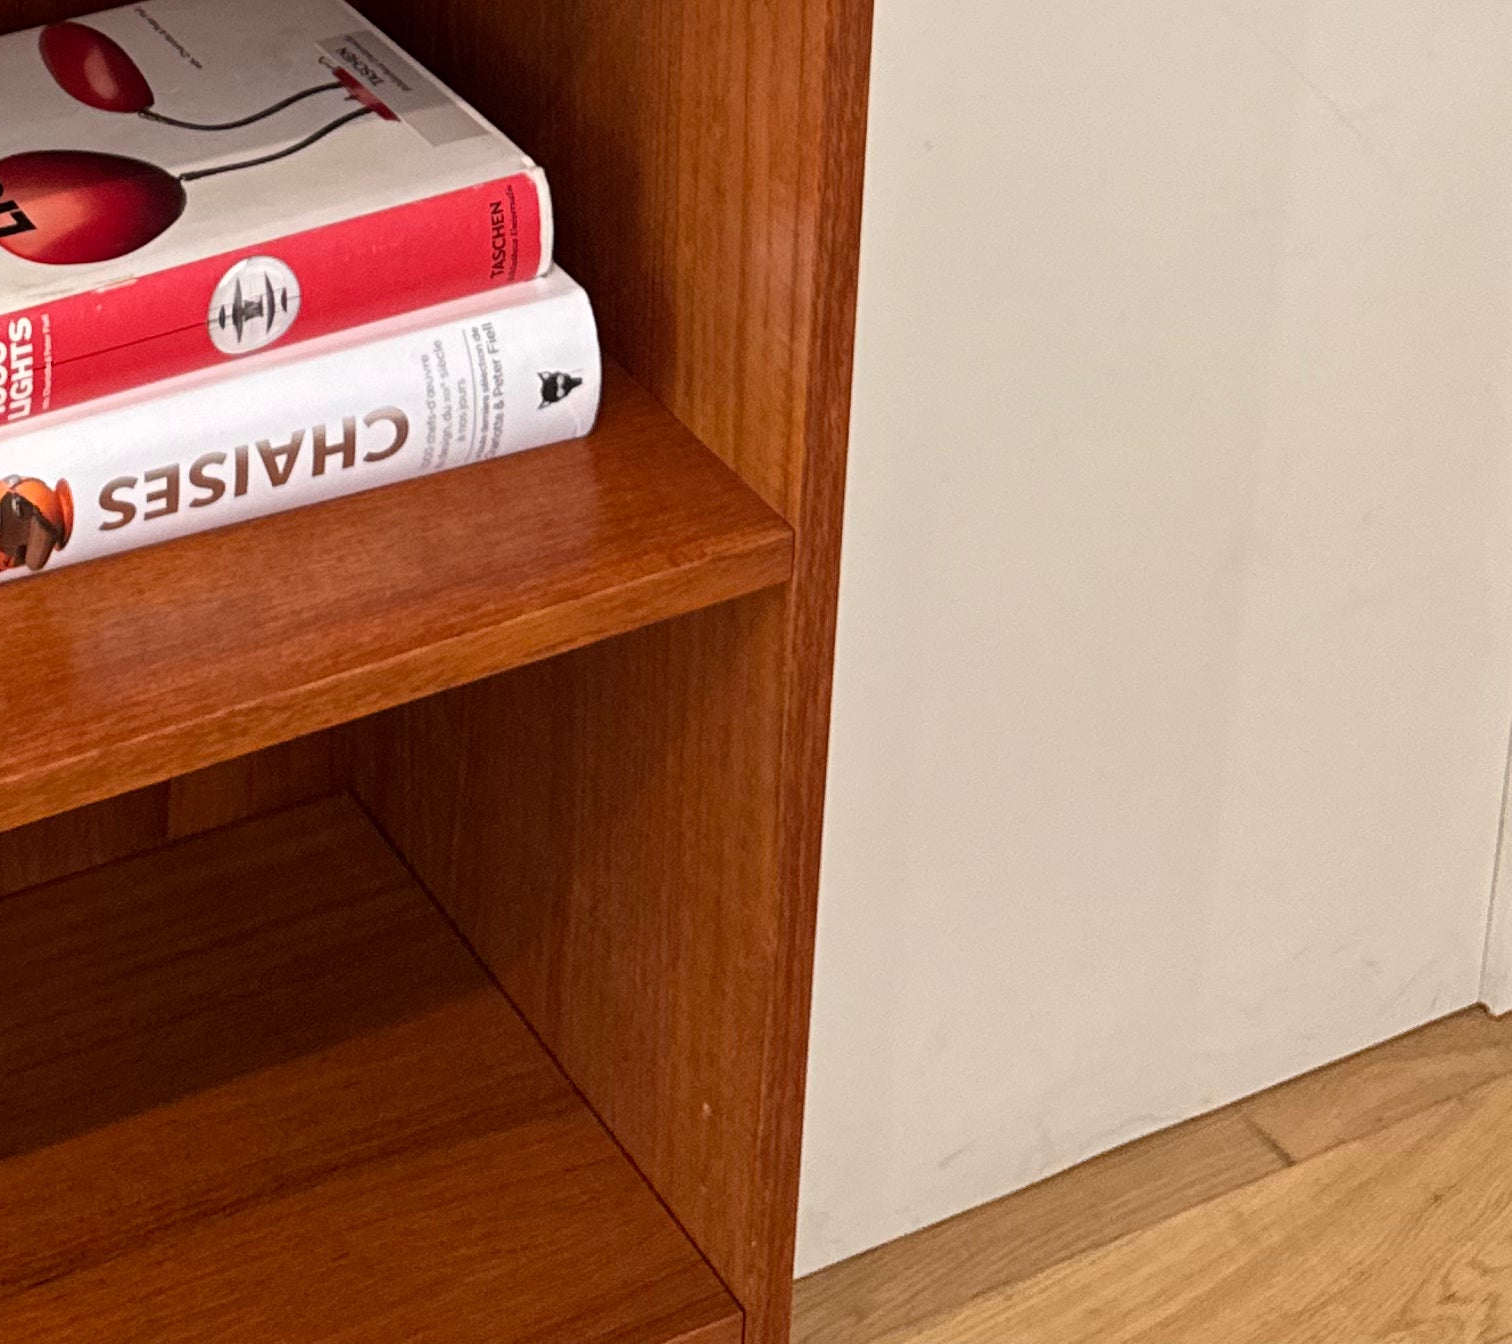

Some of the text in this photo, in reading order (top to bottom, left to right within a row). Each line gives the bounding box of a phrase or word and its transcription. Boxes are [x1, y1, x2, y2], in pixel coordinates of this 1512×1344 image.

[489, 200, 507, 280] TASCHEN
[471, 326, 481, 342] de
[480, 321, 500, 355] Fiell
[7, 316, 34, 421] LIGHTS
[491, 358, 504, 397] Peter
[456, 377, 469, 410] jours
[492, 399, 505, 410] &
[97, 405, 410, 531] CHAISES
